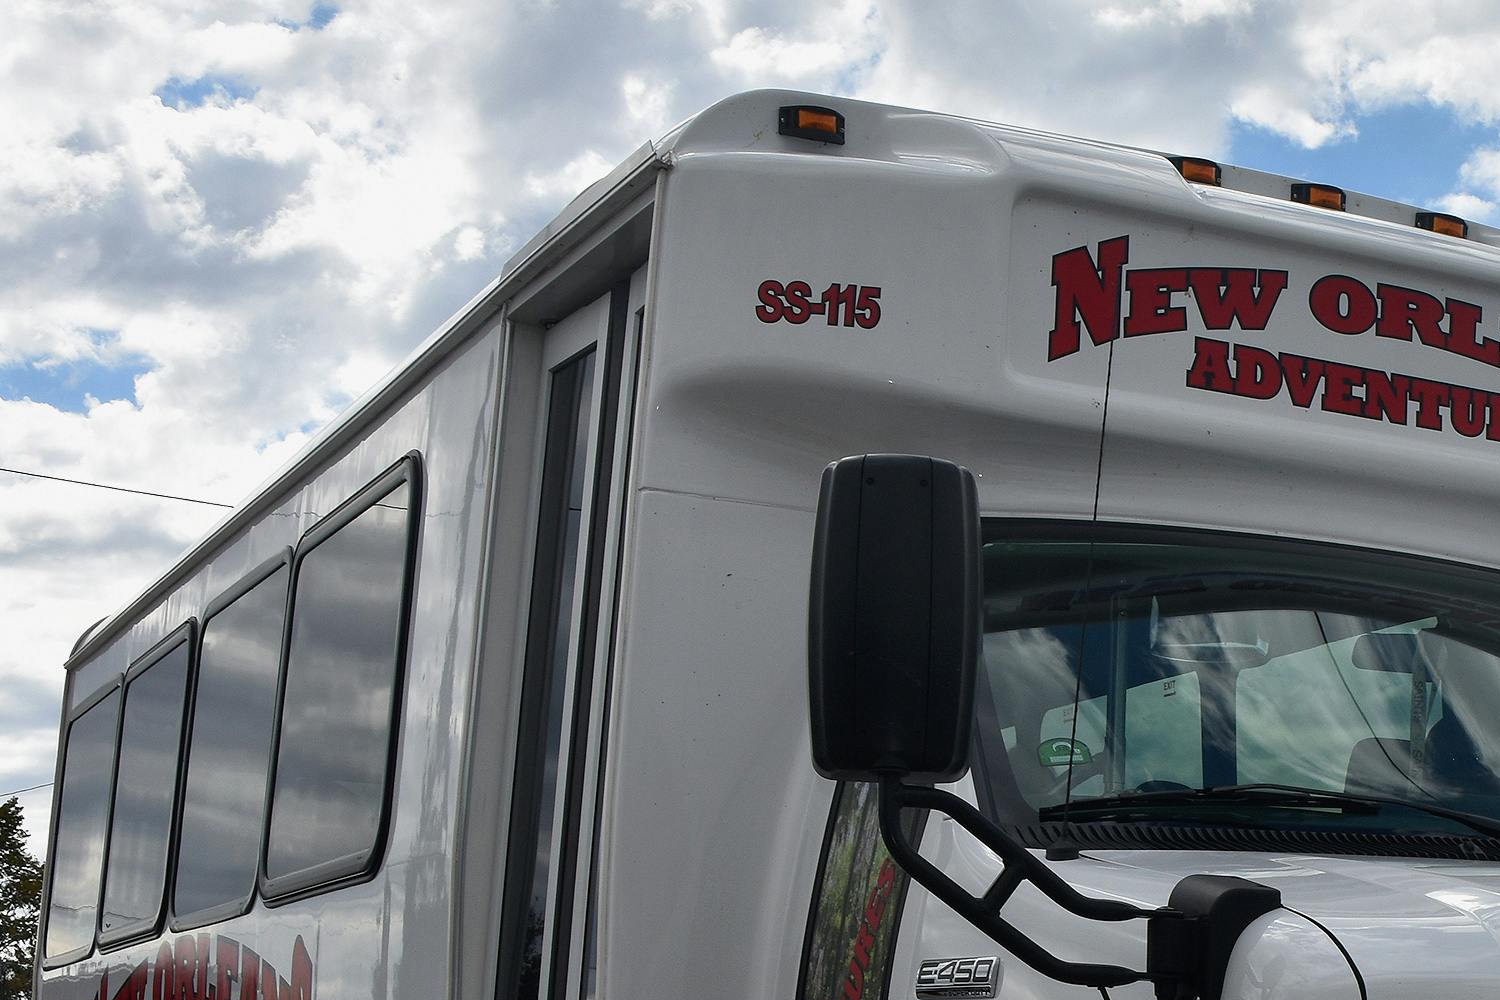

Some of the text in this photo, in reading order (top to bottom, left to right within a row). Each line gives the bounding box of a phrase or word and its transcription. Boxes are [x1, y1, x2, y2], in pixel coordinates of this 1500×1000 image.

[755, 280, 882, 329] SS-115
[1048, 234, 1289, 363] NEW
[1163, 680, 1176, 691] EXIT
[918, 959, 994, 984] E-450
